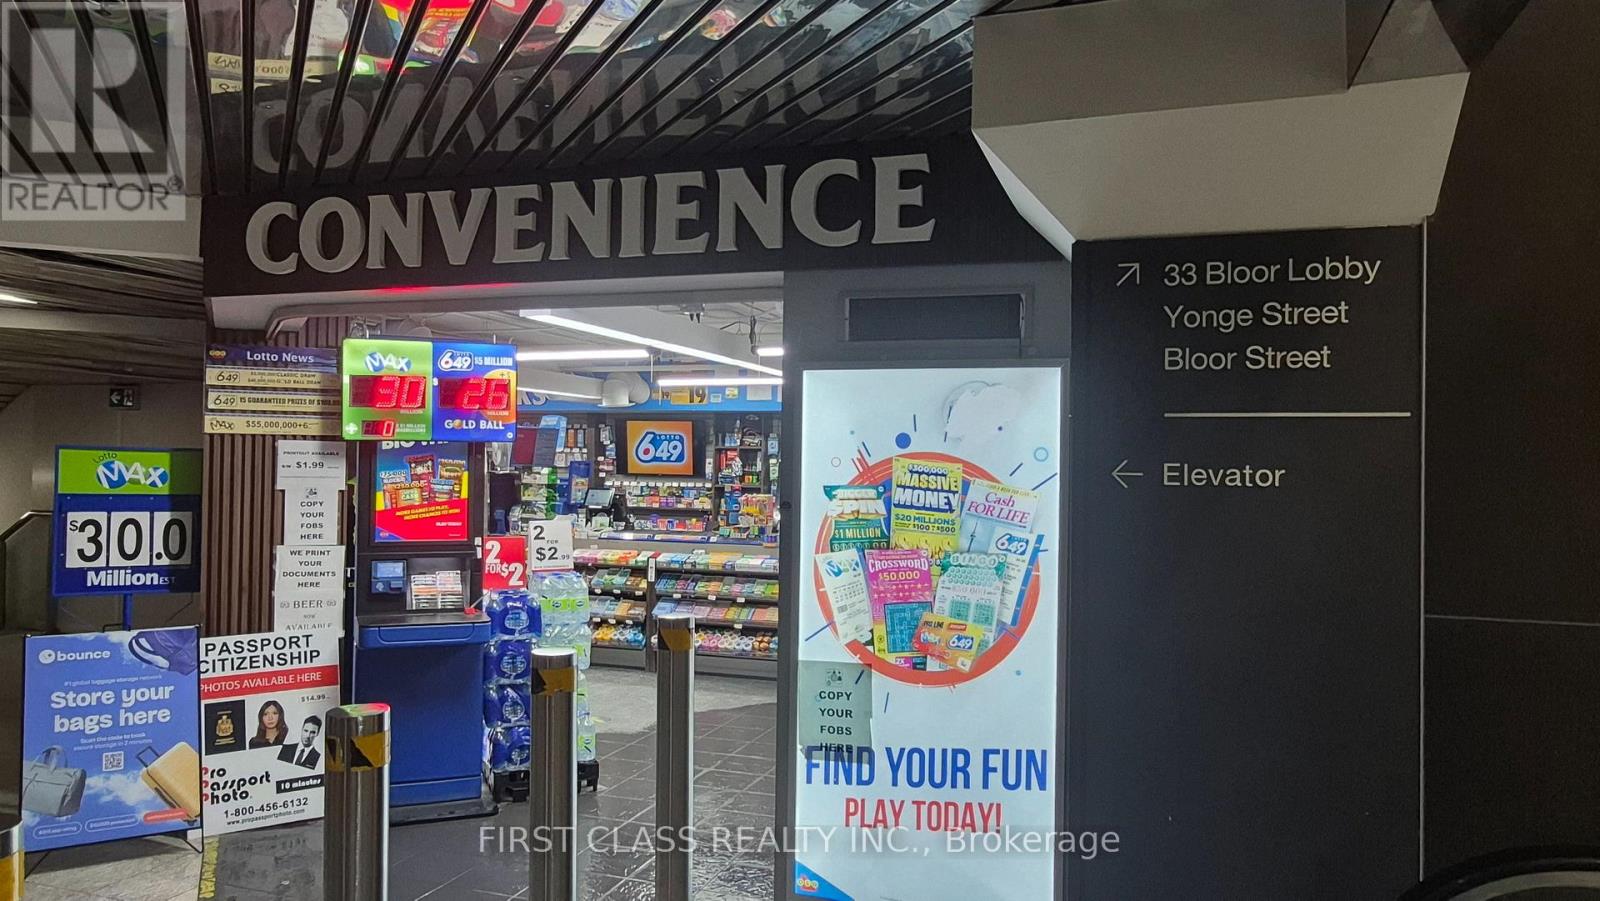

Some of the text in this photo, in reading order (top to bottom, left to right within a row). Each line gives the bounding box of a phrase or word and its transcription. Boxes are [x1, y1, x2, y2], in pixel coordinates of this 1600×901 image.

[246, 153, 935, 275] CONVENIENCE
[1164, 256, 1382, 286] 33 Bloor Lobby
[1163, 301, 1348, 332] Yonge Street
[247, 351, 314, 363] Lotto News
[365, 352, 409, 373] MAX
[484, 357, 513, 366] MILLION
[1164, 346, 1331, 370] Bloor Street
[217, 371, 239, 382] 649
[213, 395, 236, 406] 649
[463, 378, 509, 409] 26
[480, 420, 505, 430] BALL
[637, 432, 683, 462] 649
[93, 452, 118, 464] Lotto
[296, 461, 324, 469] $1.99
[97, 460, 165, 489] MAX
[897, 471, 959, 492] MASSIVE
[1163, 463, 1285, 487] Elevator
[894, 487, 960, 509] MONEY
[985, 492, 1015, 508] Cash
[895, 514, 956, 525] $20 MILLIONS
[967, 501, 1031, 524] FOR LIFE
[533, 525, 545, 540] 2
[846, 528, 881, 538] MILLION
[485, 540, 500, 563] 2
[996, 533, 1027, 554] 649
[485, 562, 524, 586] FOR $2
[869, 558, 929, 573] CROSSWORD
[87, 570, 160, 586] Million
[293, 600, 323, 609] BEER
[205, 634, 313, 657] PASSPORT
[949, 633, 973, 650] 649
[57, 650, 111, 662] bounce
[200, 650, 321, 674] CITIZENSHIP
[242, 675, 295, 689] AVAILABLE
[297, 672, 322, 683] HERE
[50, 685, 175, 709] Store your
[301, 694, 326, 702] $14.99
[819, 691, 853, 701] COPY
[54, 708, 171, 735] bags here
[819, 708, 853, 718] YOUR
[820, 725, 853, 735] FOBS
[820, 743, 853, 753] HERE
[806, 746, 1048, 791] FIND YOUR FUN
[292, 778, 321, 788] minutes
[224, 797, 309, 819] 1-800-456-6132
[845, 797, 1002, 834] PLAY TODAY!
[227, 809, 305, 826] www.propassportphoto.com
